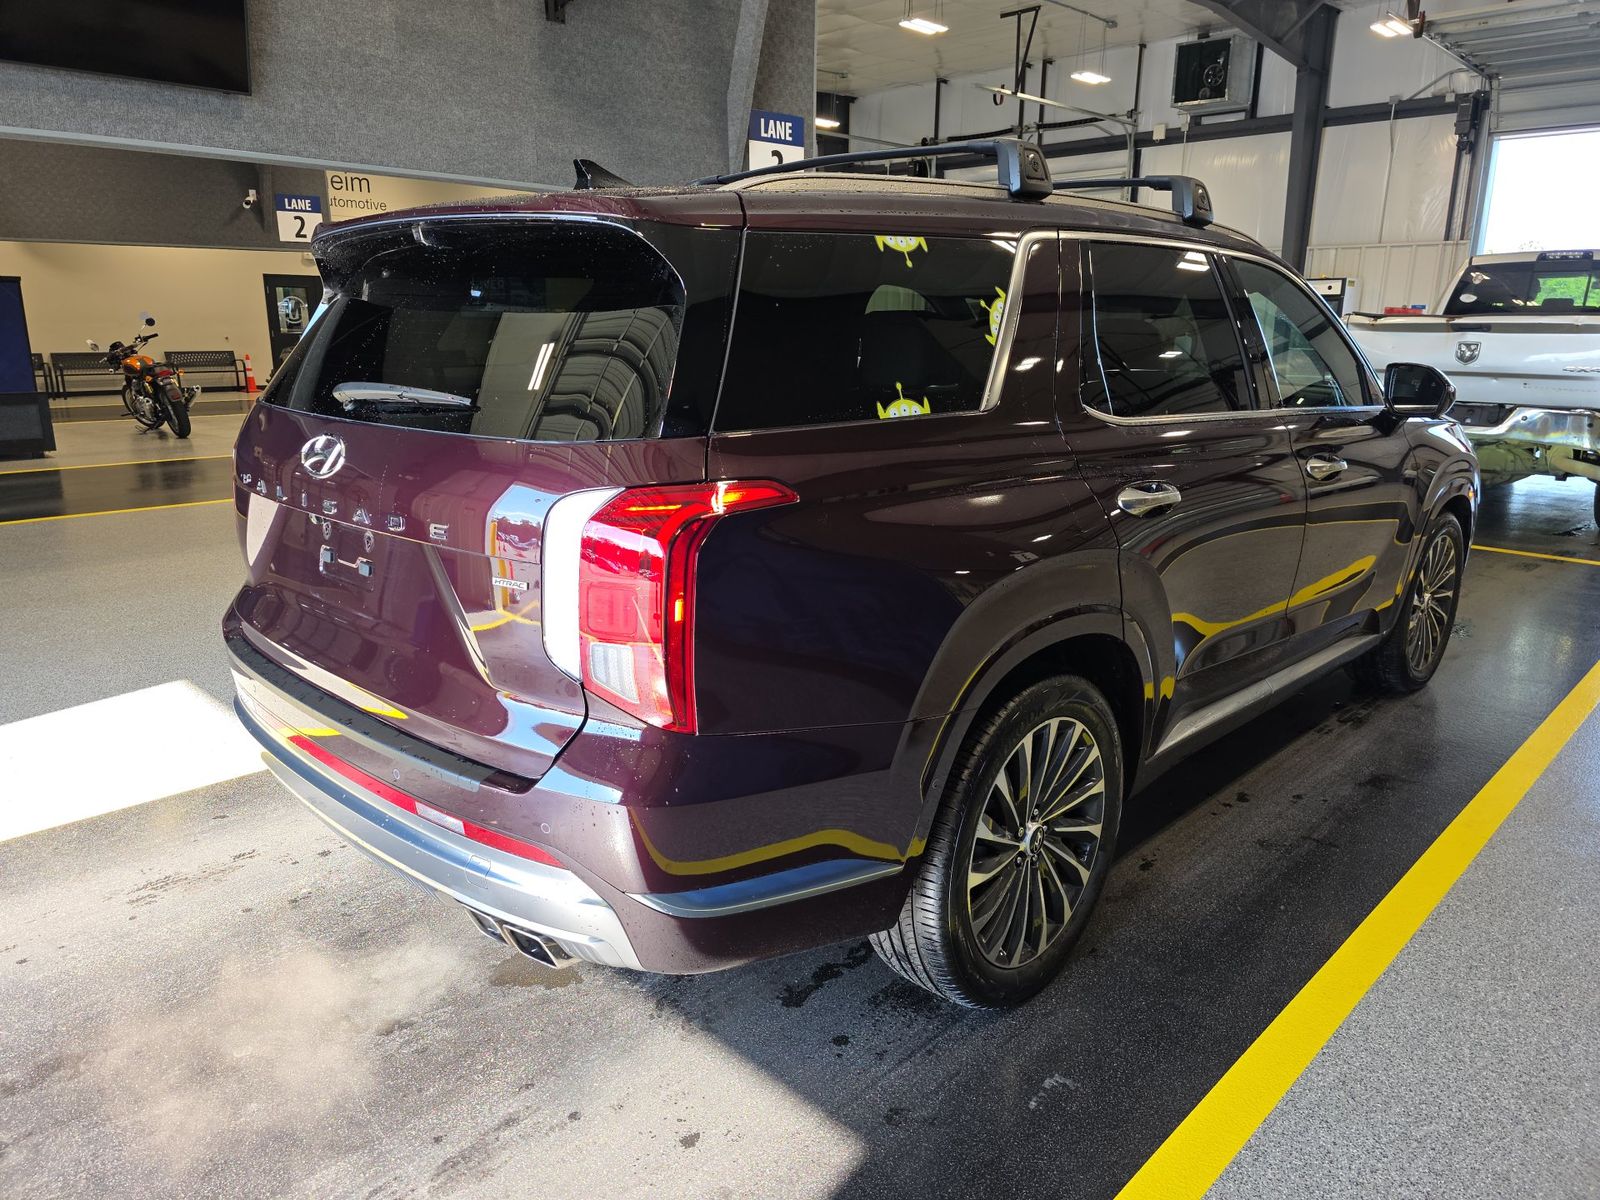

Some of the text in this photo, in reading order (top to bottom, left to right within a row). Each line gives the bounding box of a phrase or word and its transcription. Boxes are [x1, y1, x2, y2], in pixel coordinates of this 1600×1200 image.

[760, 117, 793, 141] LANE
[330, 172, 371, 193] eim
[284, 198, 312, 211] LANE
[293, 216, 307, 238] 2
[241, 473, 449, 540] PALISADE
[494, 578, 526, 589] HTRAC
